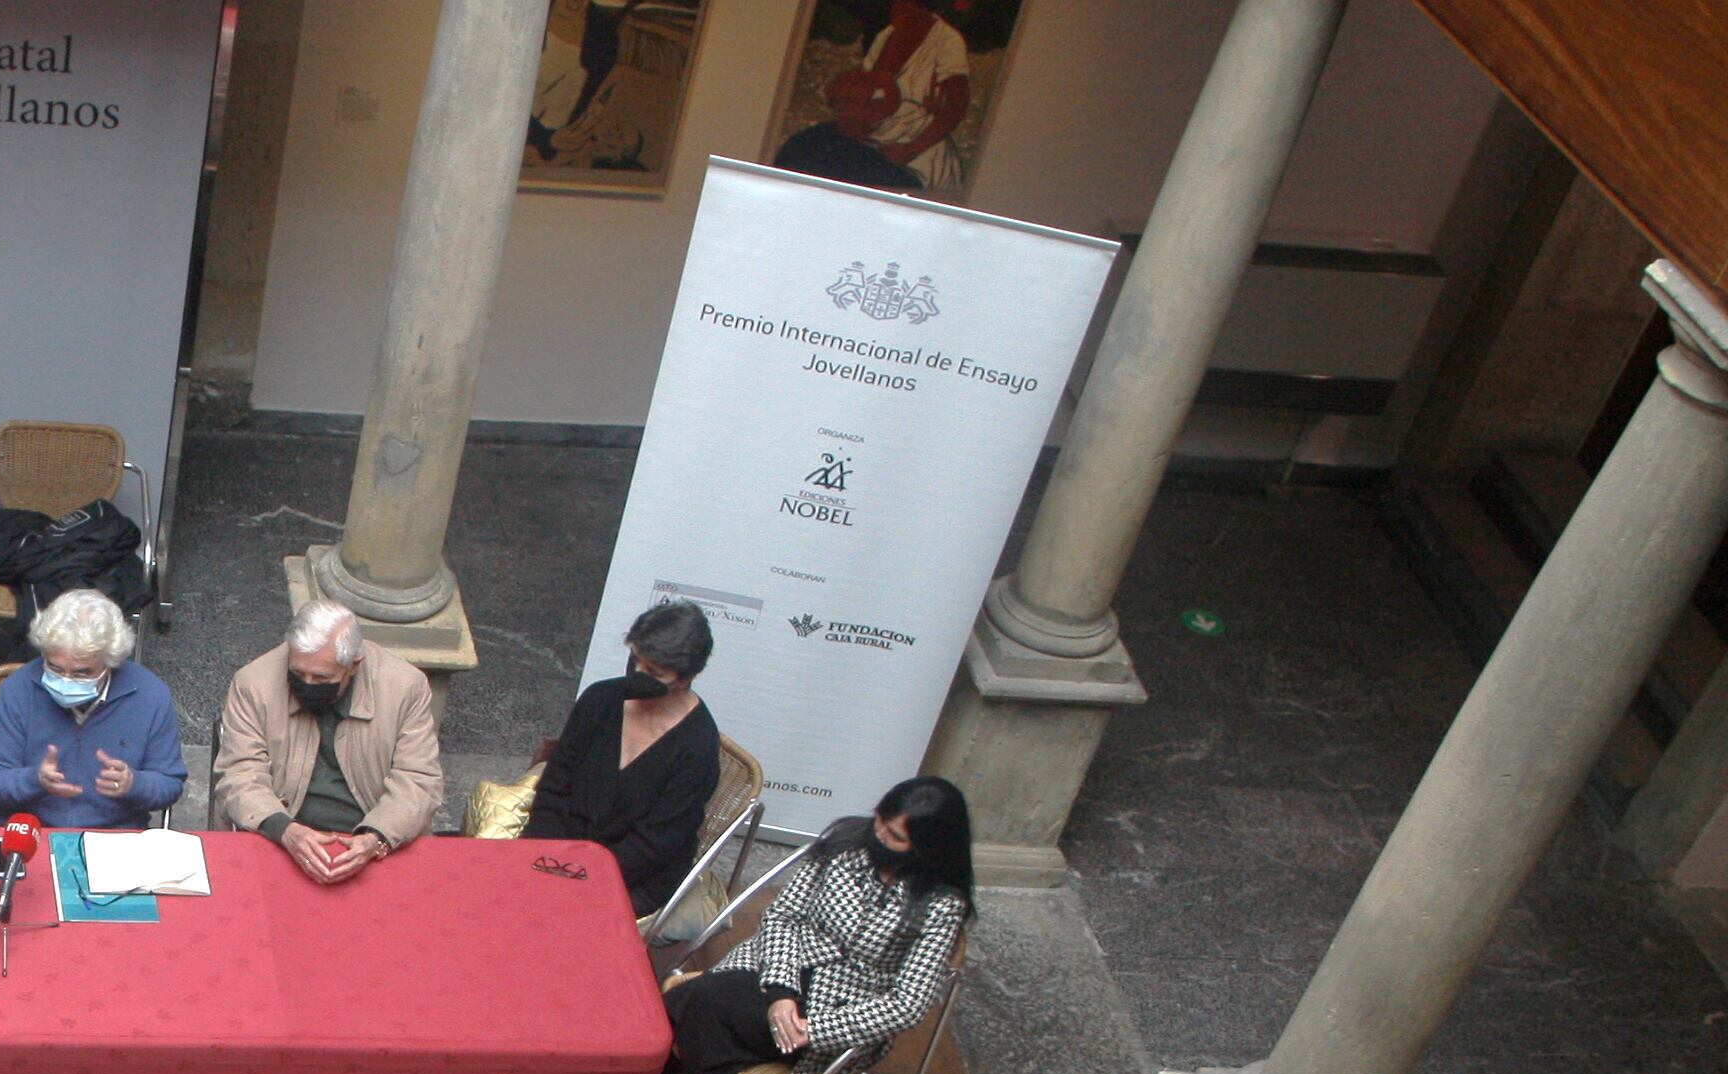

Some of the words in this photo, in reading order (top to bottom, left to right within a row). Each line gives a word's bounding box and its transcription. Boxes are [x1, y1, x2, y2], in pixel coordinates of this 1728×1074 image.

[699, 303, 774, 336] Premio
[779, 320, 923, 366] Internacional
[925, 349, 952, 371] de
[957, 356, 1038, 395] Ensayo
[801, 353, 918, 392] Jovellanos
[817, 427, 864, 443] ORGANIZA
[779, 497, 854, 526] NOBEL
[770, 566, 826, 583] COLABORAN
[824, 633, 852, 643] CAJA
[854, 636, 893, 650] RURAL
[828, 621, 916, 646] FUNDACION
